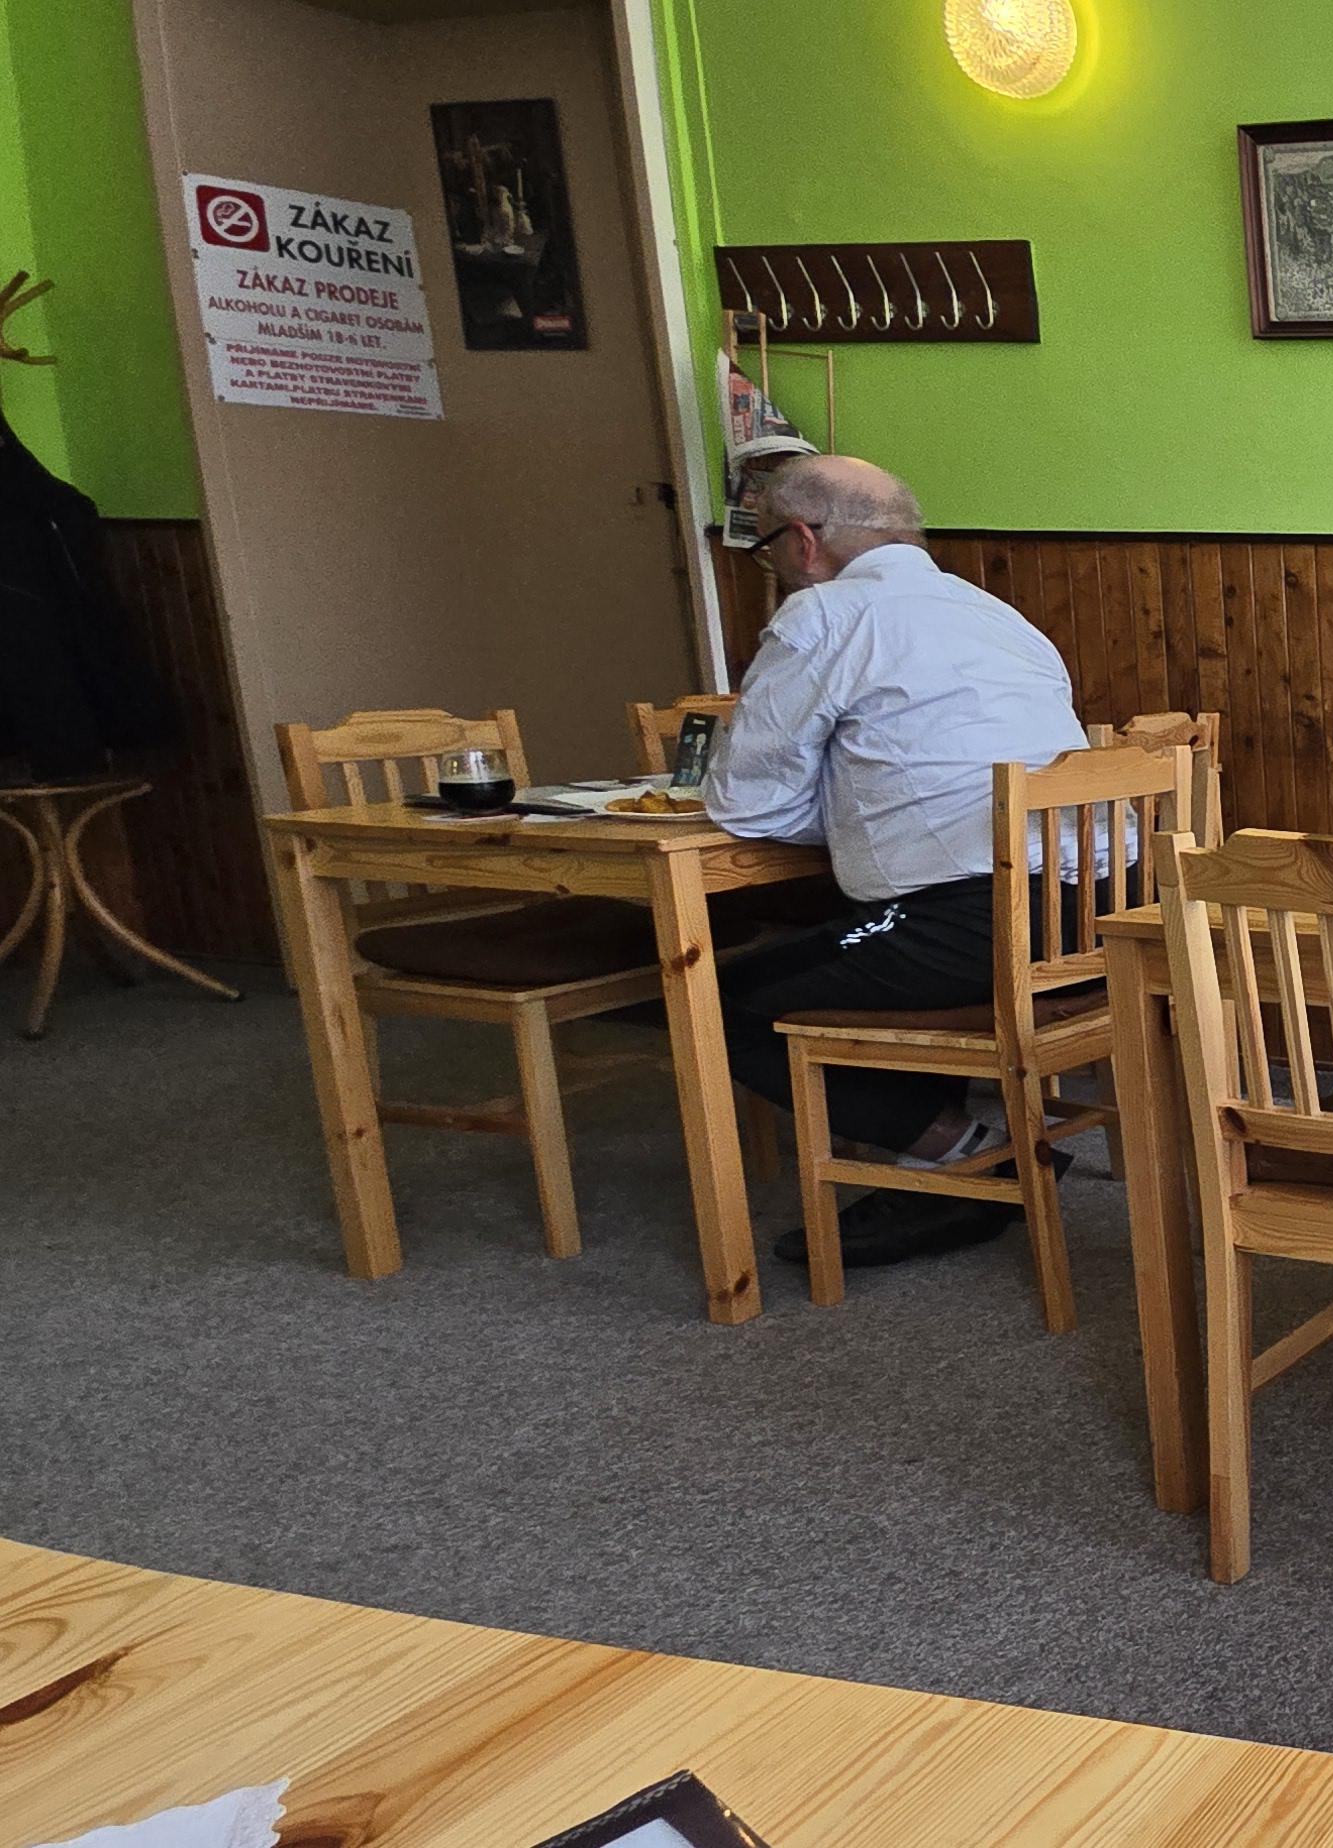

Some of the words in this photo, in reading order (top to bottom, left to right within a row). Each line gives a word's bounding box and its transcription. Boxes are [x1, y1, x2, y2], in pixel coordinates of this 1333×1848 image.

[288, 201, 393, 243] ZÁKAZ
[275, 235, 414, 277] KOUŘENÍ
[236, 266, 309, 297] ZÁKAZ
[314, 280, 399, 310] PRODEJE
[208, 295, 286, 318] ALKOHOLU
[289, 306, 301, 319] A
[305, 308, 361, 327] CIGARET
[365, 314, 424, 333] OSOBÁM
[258, 321, 322, 341] MLADŠÍM
[230, 356, 266, 367] NEBO
[376, 371, 420, 383] PLATBY
[244, 368, 255, 377] A
[257, 369, 306, 382] PLATBY
